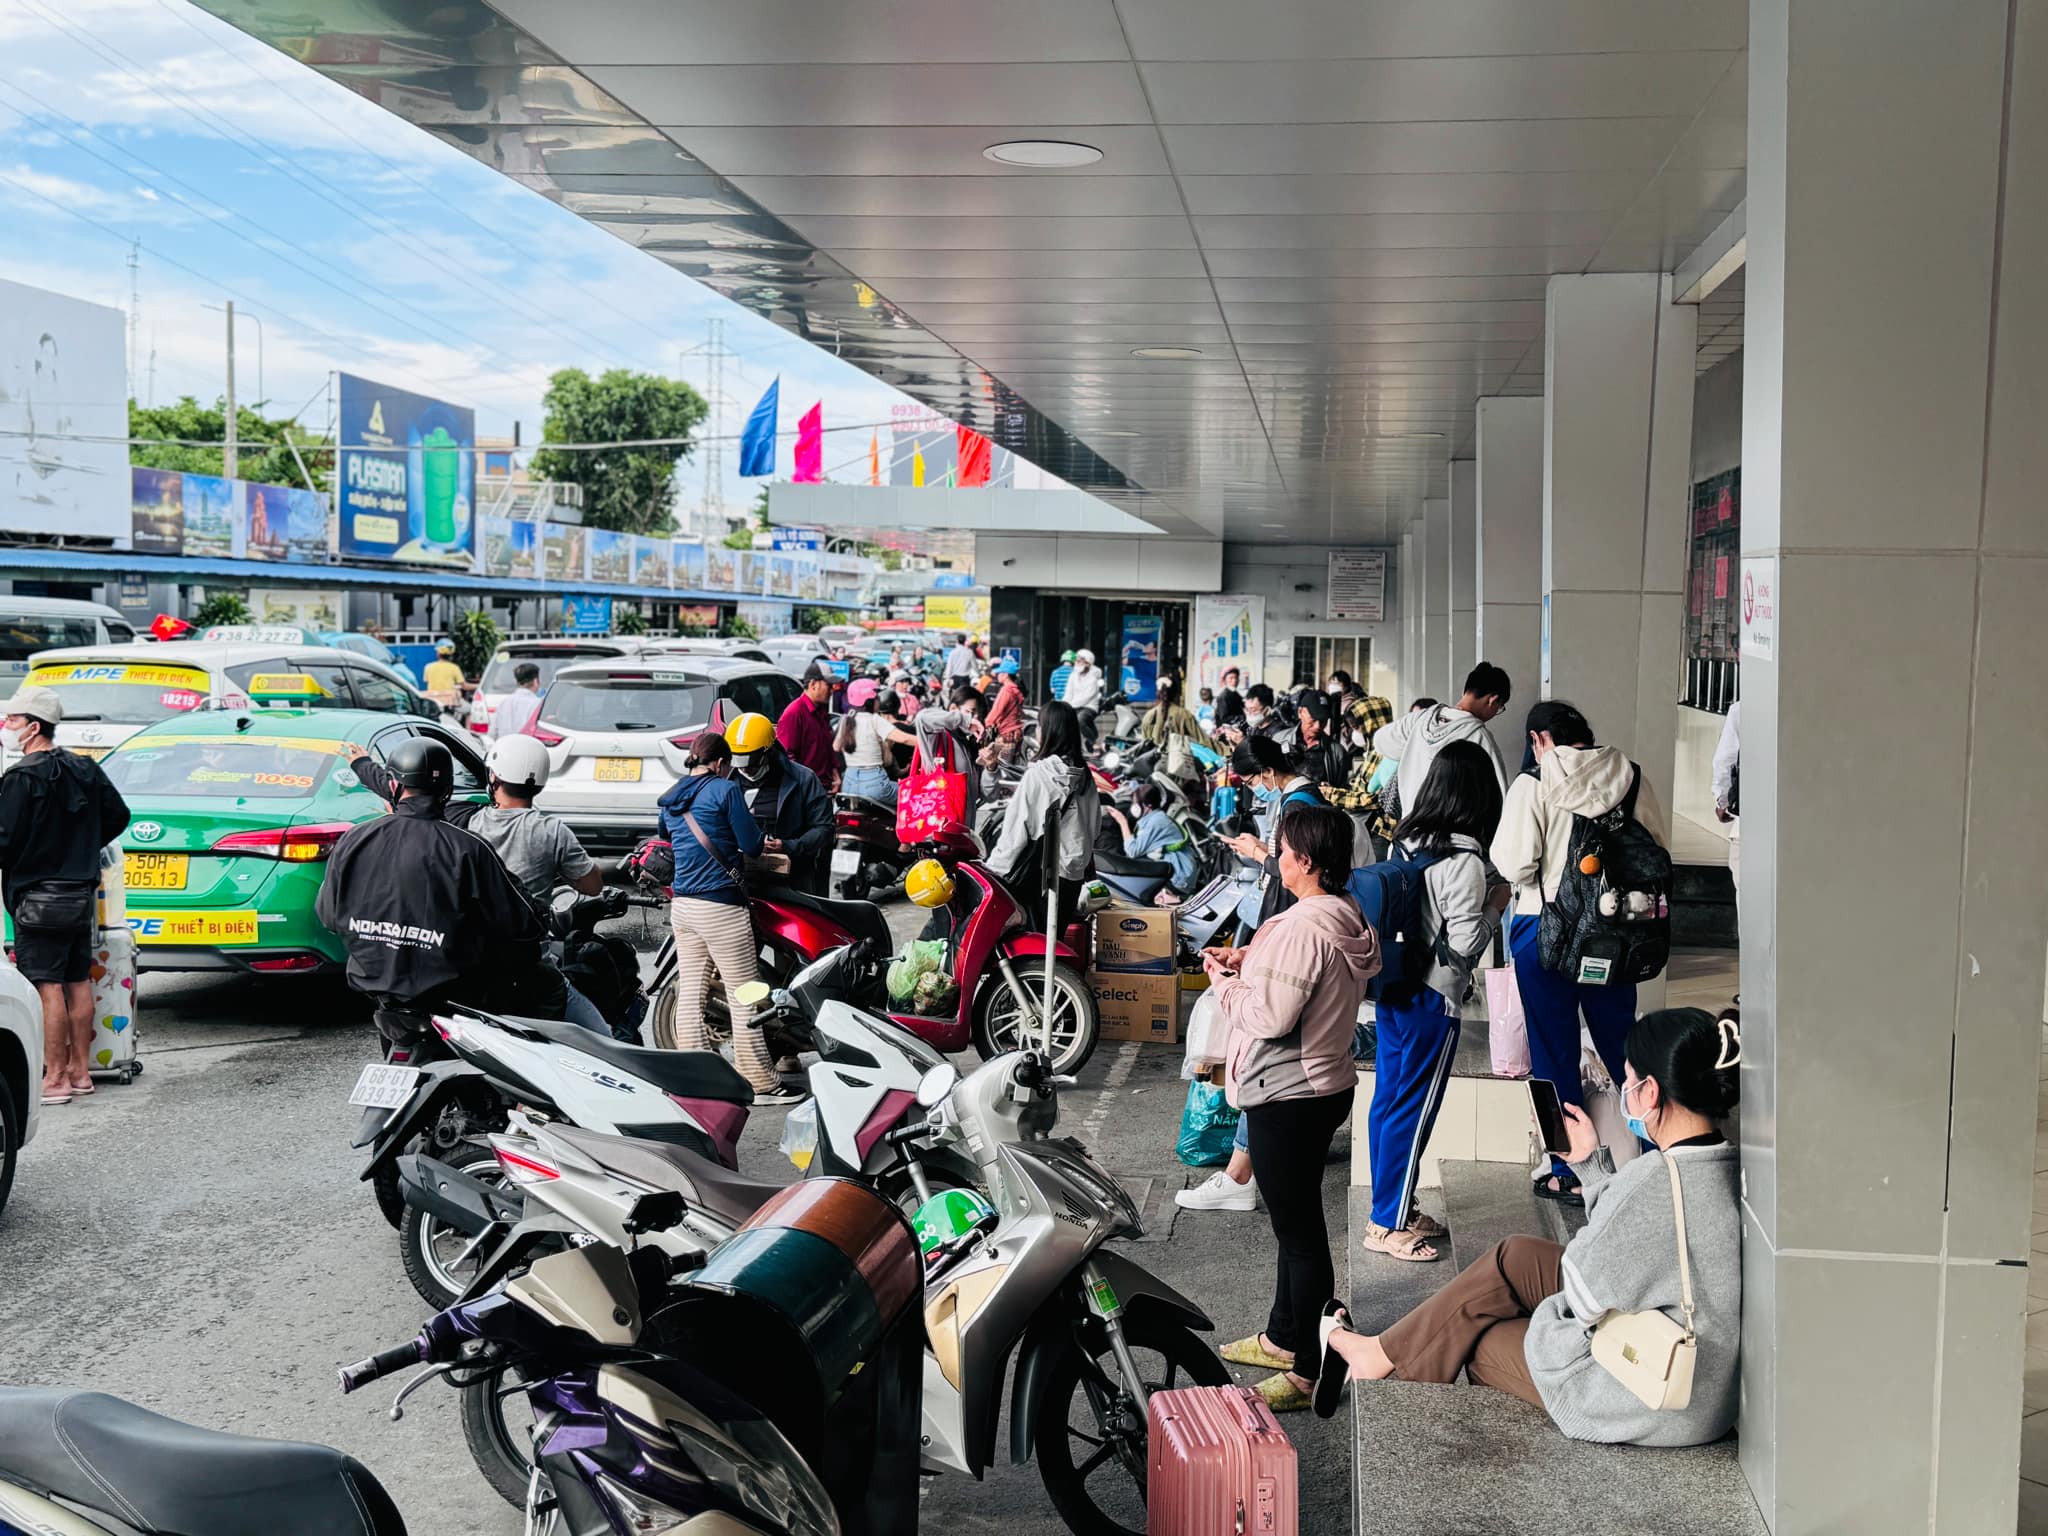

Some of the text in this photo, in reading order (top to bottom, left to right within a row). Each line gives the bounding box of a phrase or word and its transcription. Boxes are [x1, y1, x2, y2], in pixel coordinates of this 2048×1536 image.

[69, 667, 127, 680] MPE
[162, 693, 196, 707] 18215
[255, 773, 314, 787] 1055
[136, 854, 168, 869] 50H
[125, 917, 254, 936] PE THIẾT BỊ ĐIỆN
[349, 916, 445, 947] NOWSAIGON
[1094, 987, 1139, 1001] Select
[1055, 1212, 1088, 1230] HONDA
